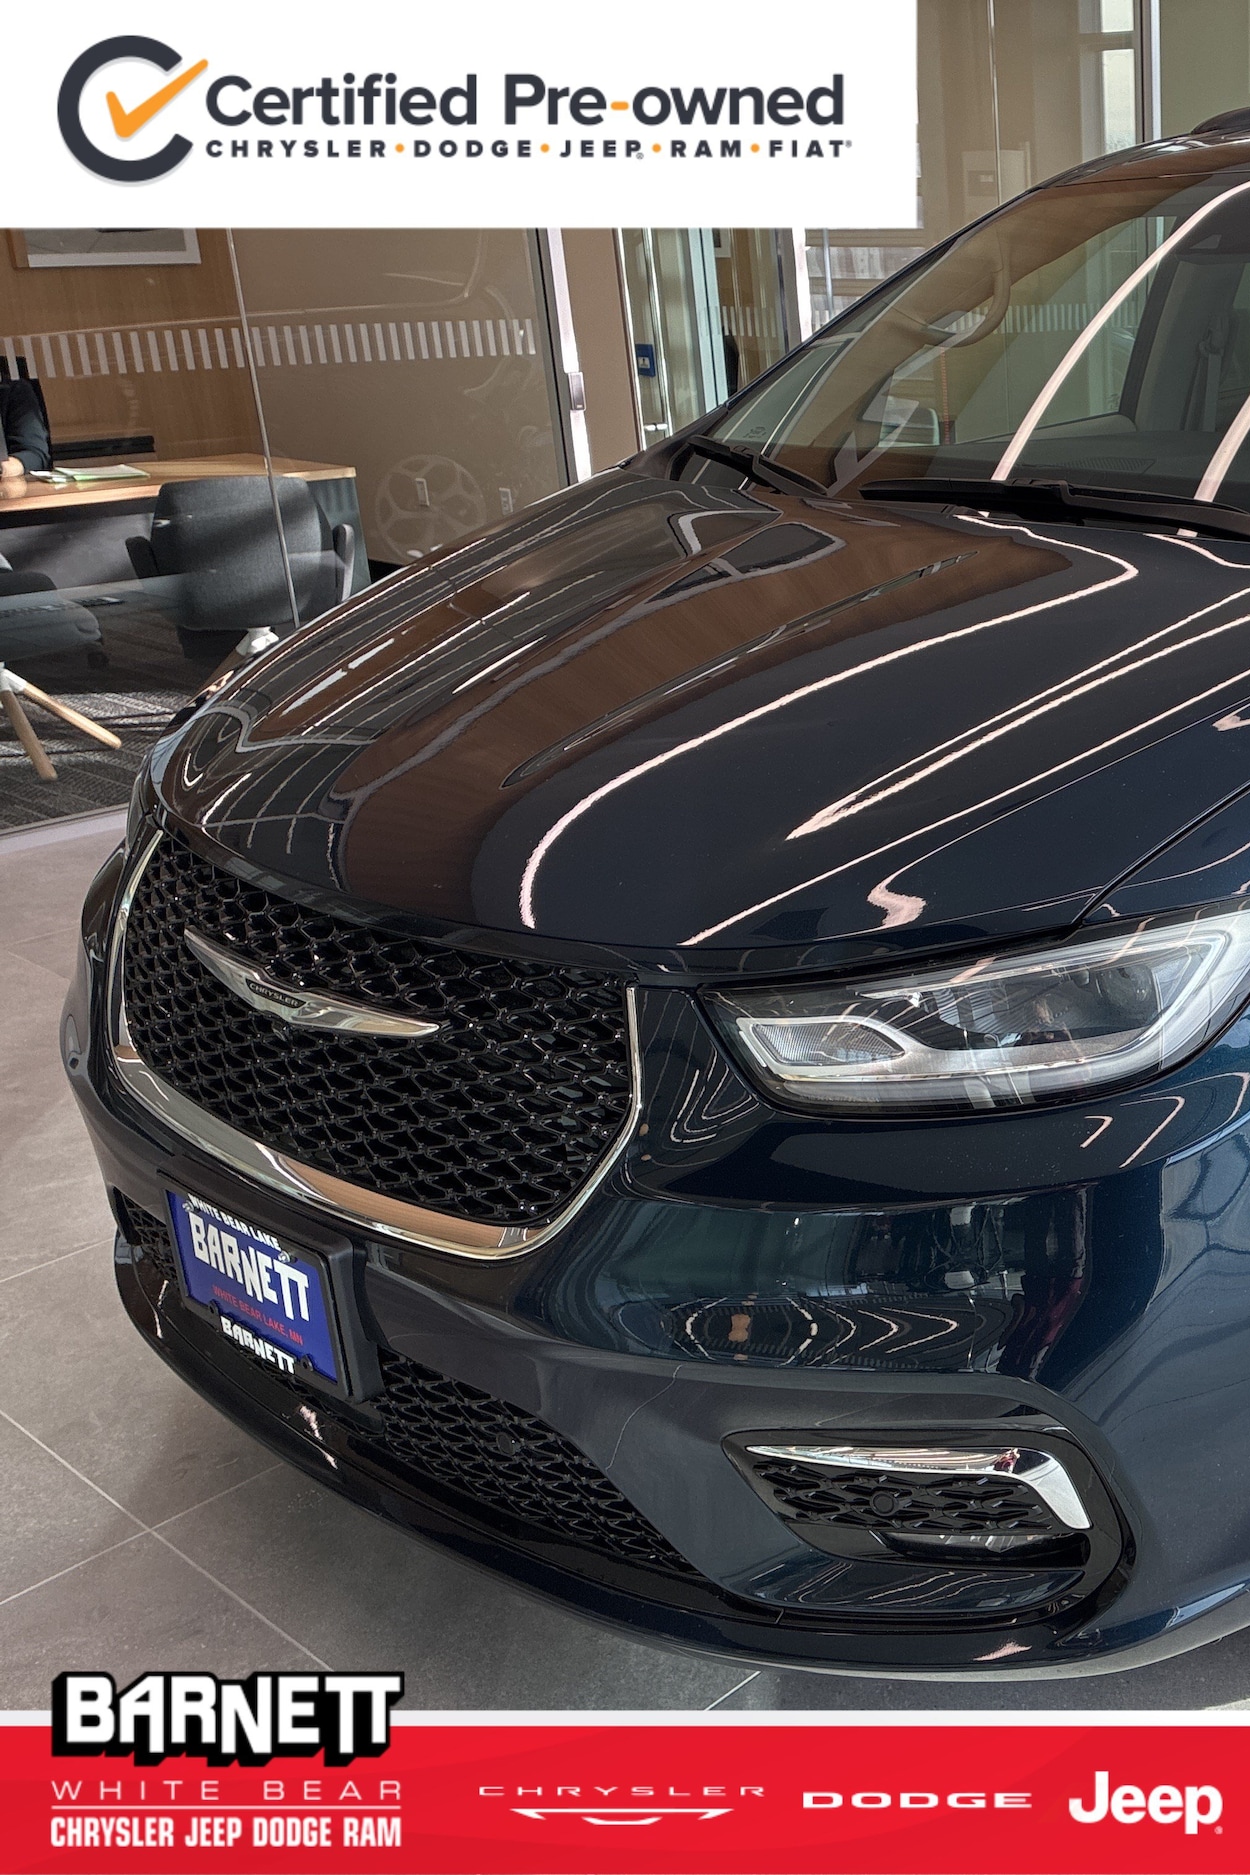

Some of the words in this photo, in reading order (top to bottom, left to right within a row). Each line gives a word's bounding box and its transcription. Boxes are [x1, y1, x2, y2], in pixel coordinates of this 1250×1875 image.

[249, 982, 299, 1007] CHRYSLER
[187, 1193, 222, 1222] WHITE
[220, 1211, 251, 1237] BEAR
[249, 1226, 282, 1252] LAKE
[188, 1211, 310, 1322] BARNETT
[212, 1284, 239, 1308] WHITE
[239, 1300, 264, 1322] BEAR
[288, 1328, 304, 1346] MN
[220, 1315, 296, 1375] BARNETT
